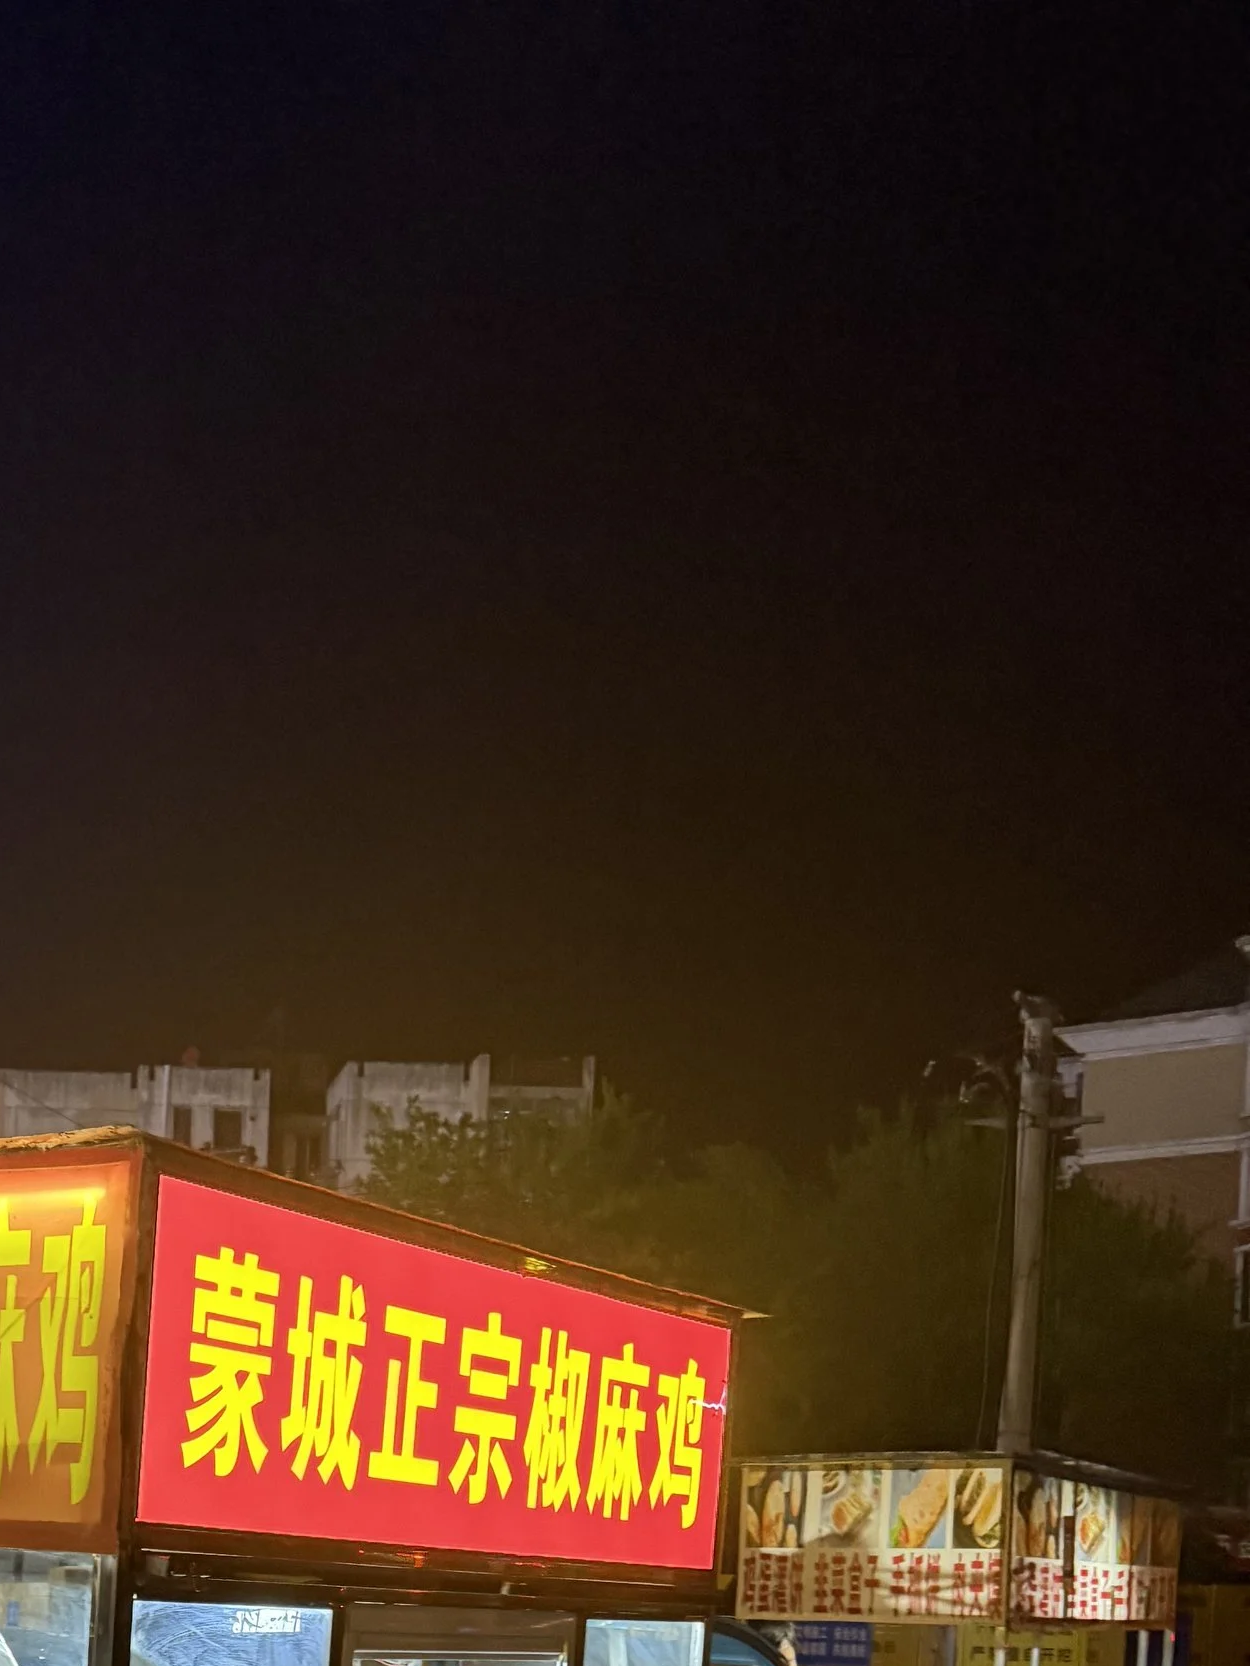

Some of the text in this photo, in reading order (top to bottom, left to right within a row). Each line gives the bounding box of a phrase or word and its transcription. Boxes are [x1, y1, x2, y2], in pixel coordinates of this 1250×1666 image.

[181, 1246, 707, 1530] 蒙城正宗椒麻鸡
